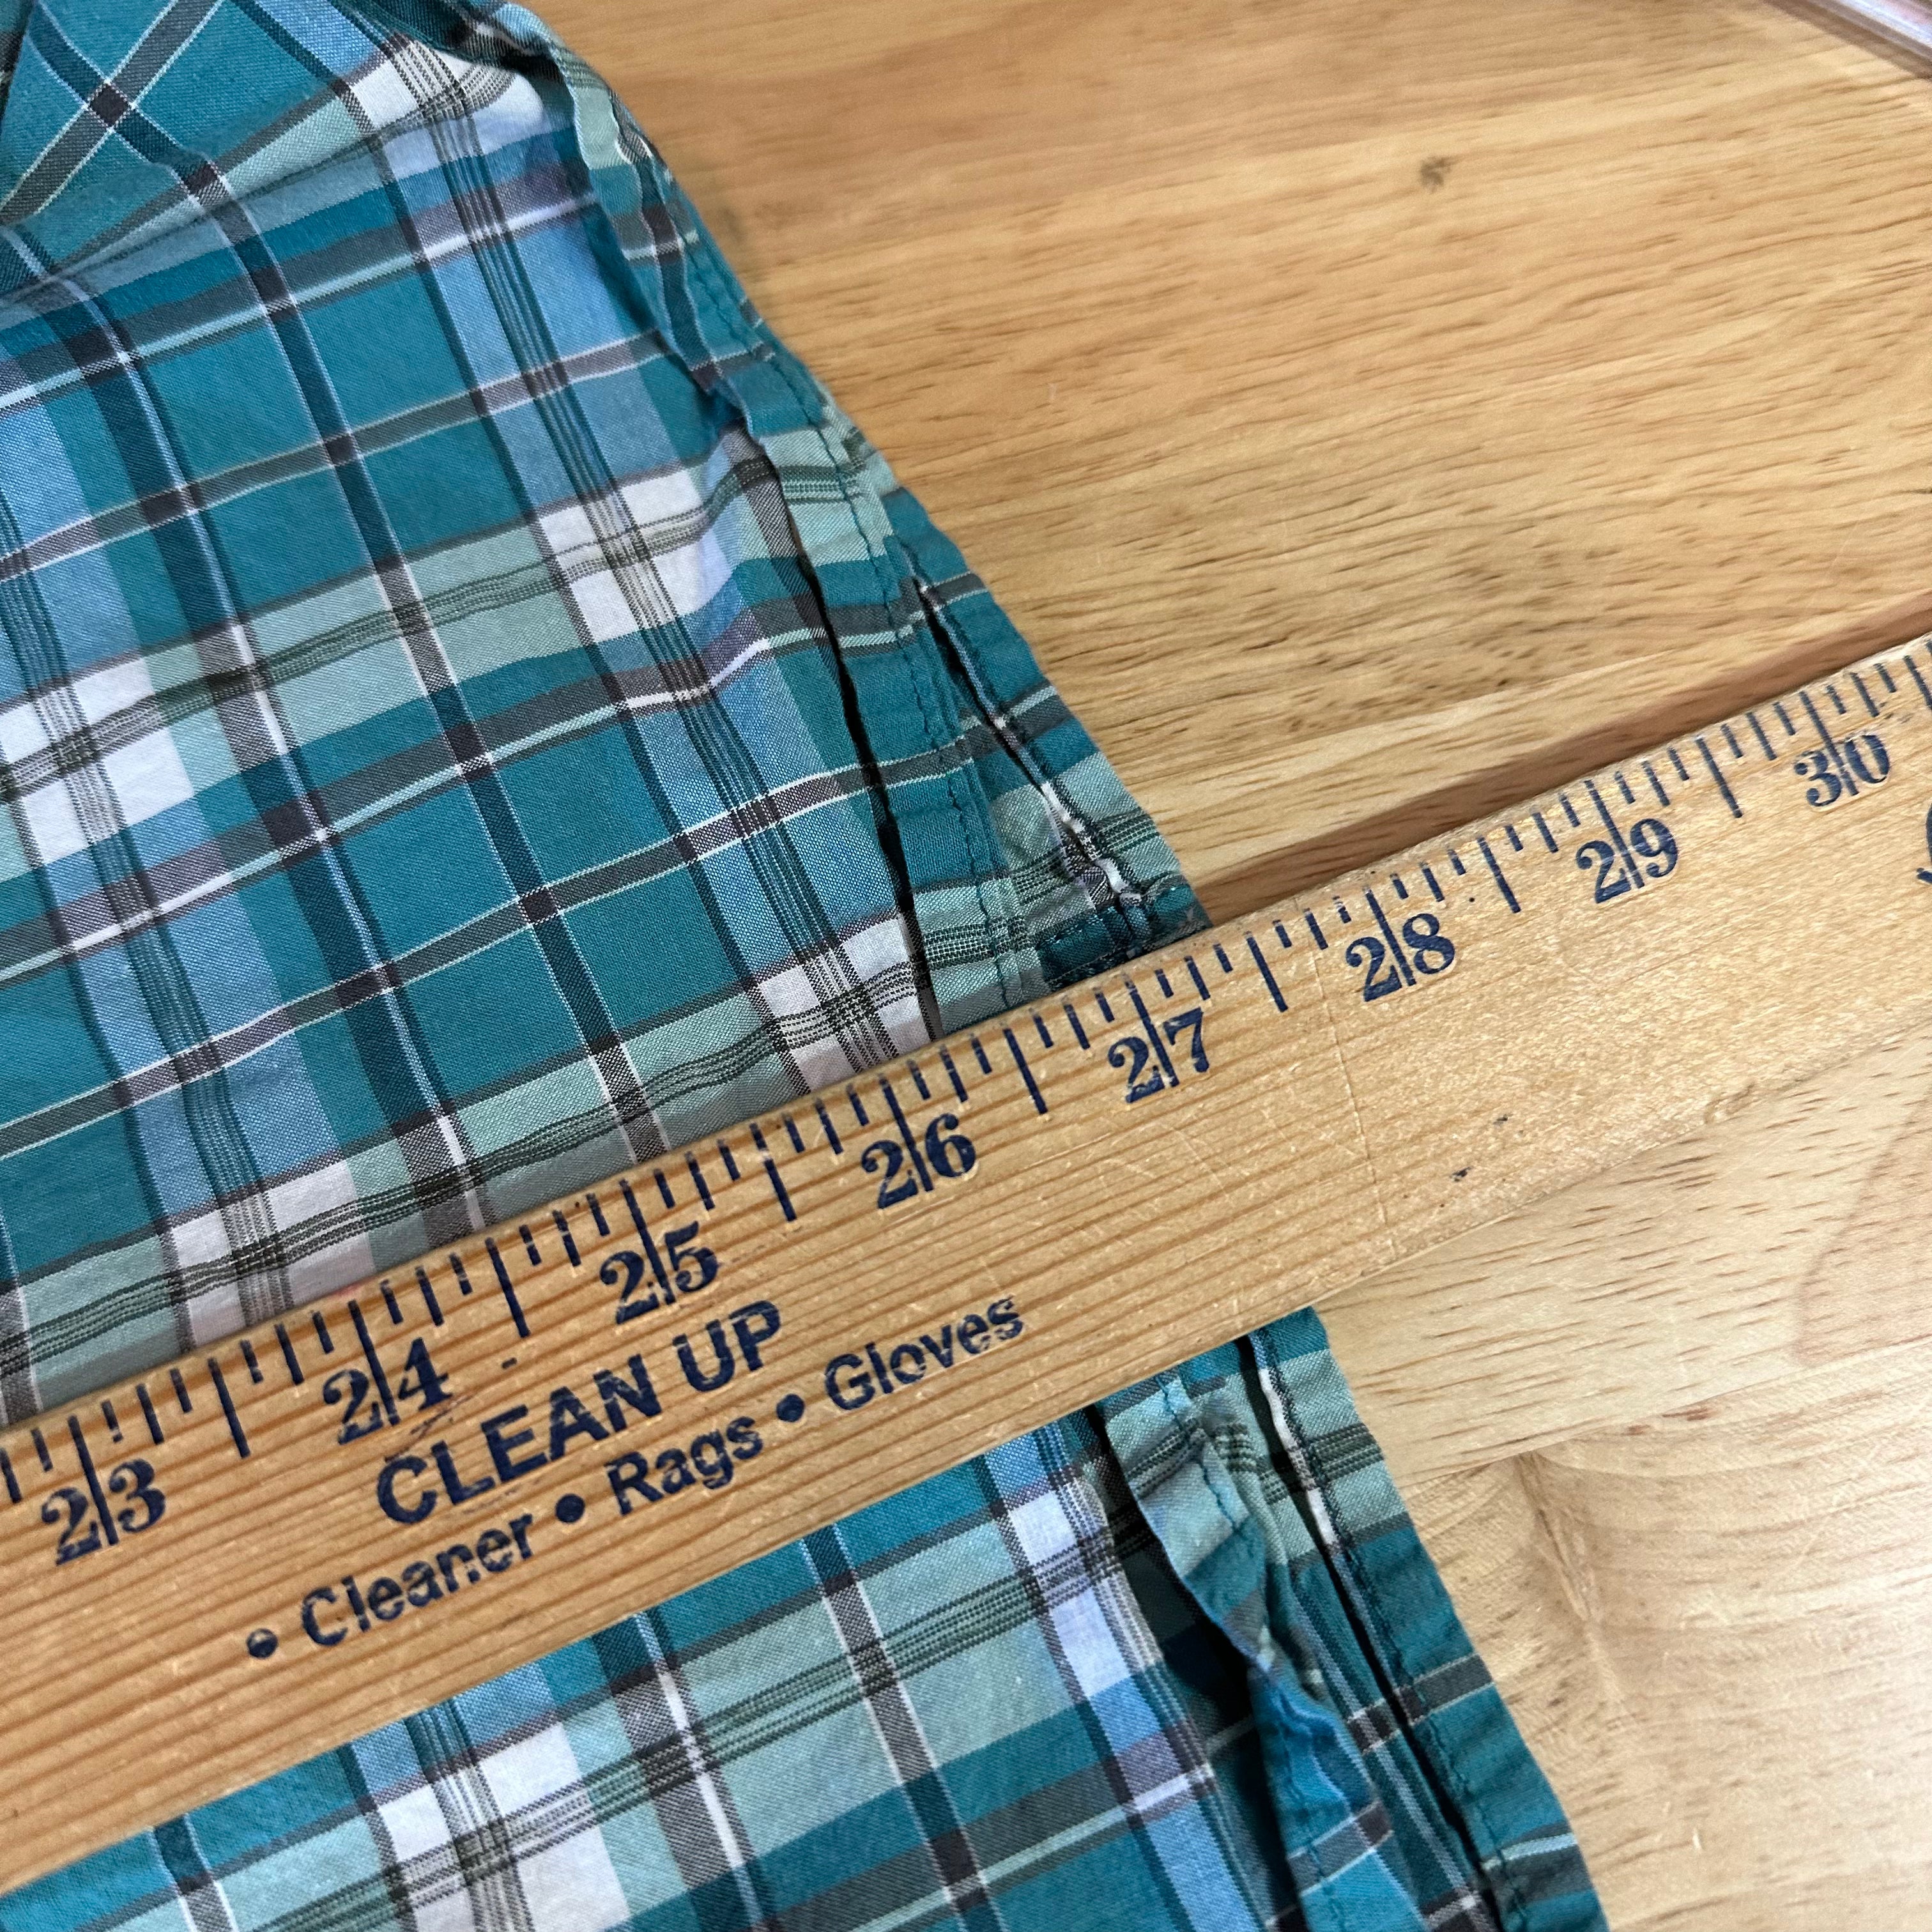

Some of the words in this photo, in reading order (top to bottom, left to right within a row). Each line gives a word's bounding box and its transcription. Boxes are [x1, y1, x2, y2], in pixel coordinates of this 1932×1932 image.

[42, 1459, 166, 1565] 23
[323, 1337, 452, 1445] 24
[599, 1220, 719, 1324] 25
[861, 1113, 976, 1209] 26
[1107, 1007, 1209, 1104] 27
[1346, 913, 1455, 1002] 28
[1575, 818, 1678, 904] 29
[1793, 735, 1890, 807] 30
[301, 1513, 535, 1646] Cleaner
[606, 1415, 764, 1516] Rags
[825, 1294, 1024, 1411] Gloves
[377, 1354, 663, 1524] CLEAN
[673, 1300, 781, 1393] UP
